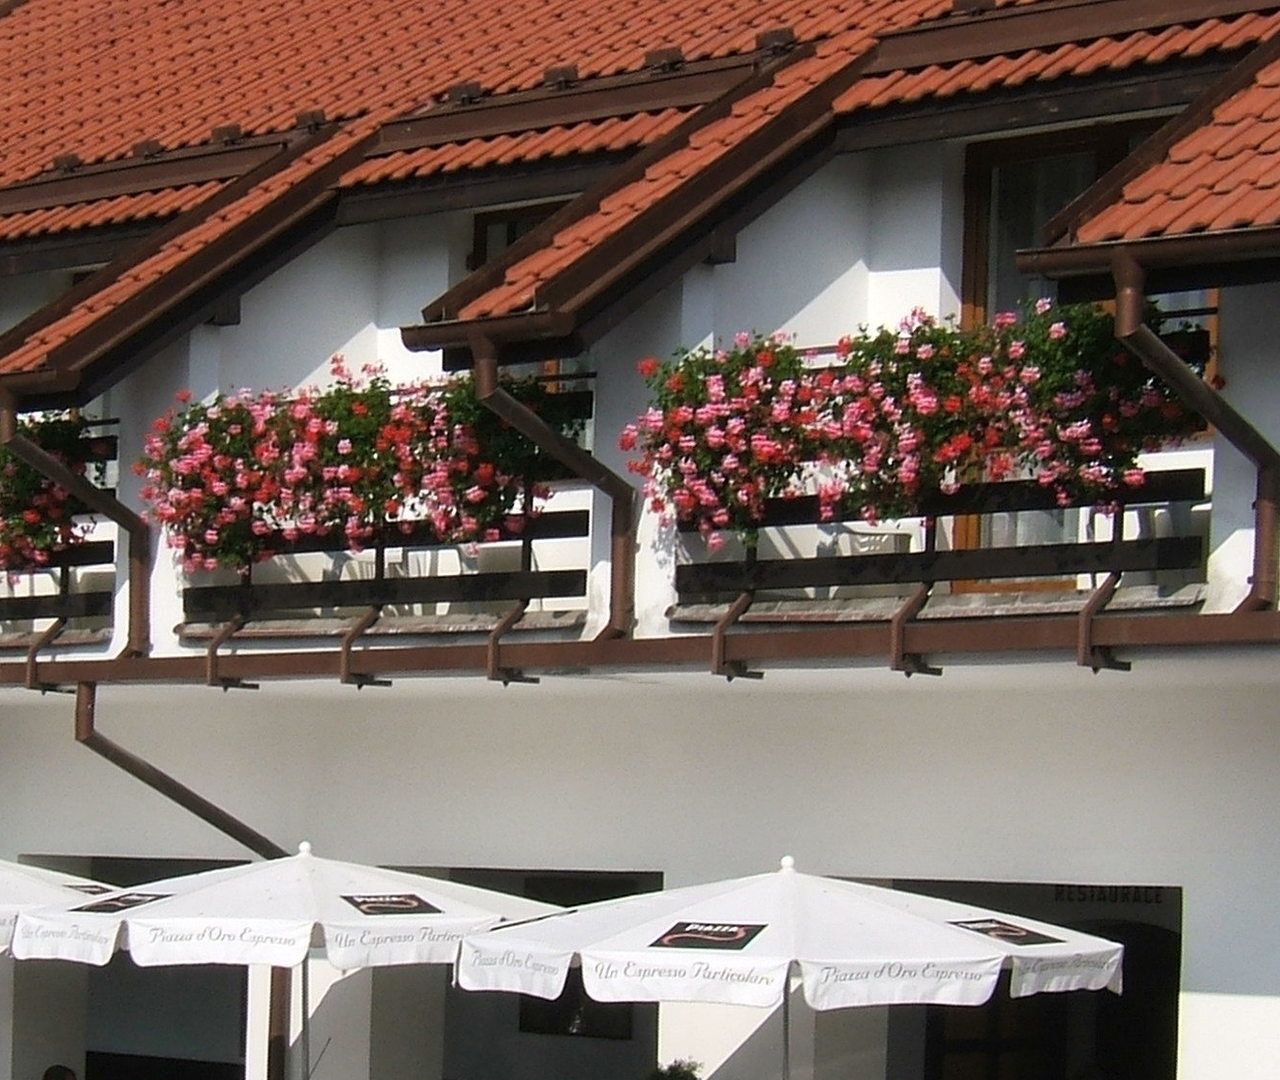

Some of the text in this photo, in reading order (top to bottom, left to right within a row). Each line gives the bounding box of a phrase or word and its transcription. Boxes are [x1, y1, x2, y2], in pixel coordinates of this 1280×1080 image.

[149, 926, 193, 944] Piazza
[239, 926, 296, 947] Espresso
[623, 961, 687, 982] Espresso
[690, 961, 776, 986] Particolare
[820, 966, 870, 984] Piazza
[921, 962, 983, 983] Espresso
